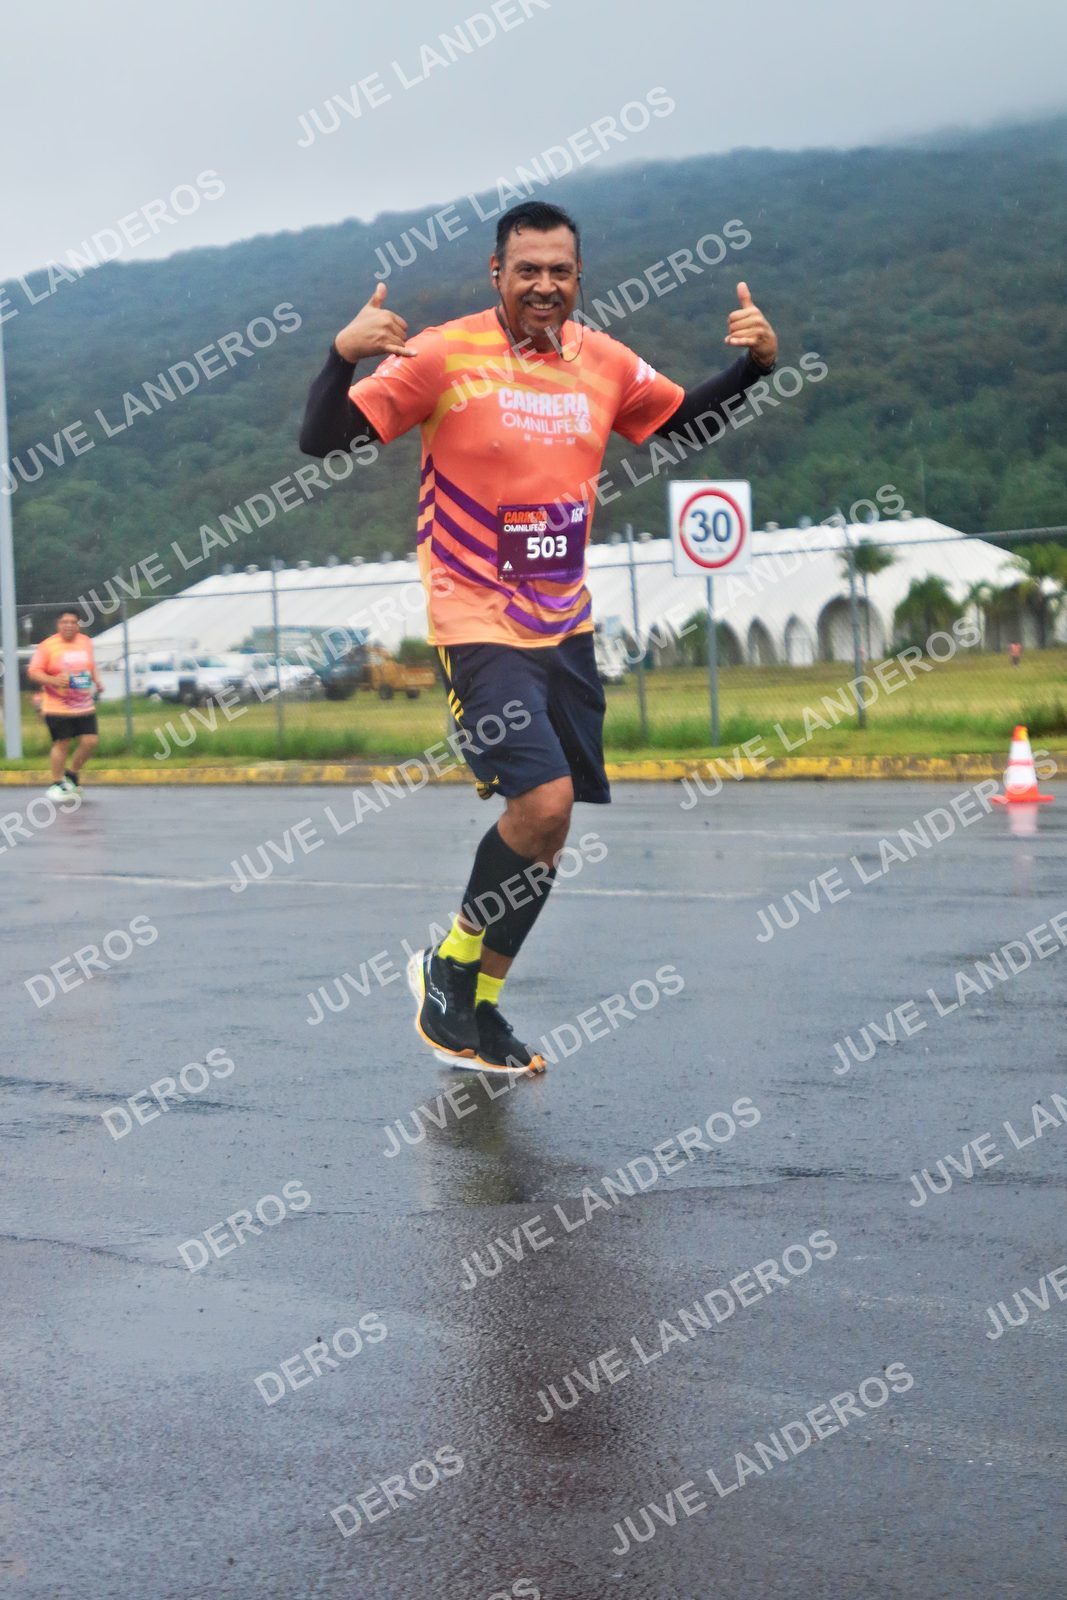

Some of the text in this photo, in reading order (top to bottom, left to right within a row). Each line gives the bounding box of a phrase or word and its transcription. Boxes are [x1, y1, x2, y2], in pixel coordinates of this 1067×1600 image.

[498, 387, 590, 416] CARRERA
[502, 412, 571, 434] OMNILIFE
[504, 510, 548, 524] CARRERA
[504, 523, 539, 532] OMNILIFE
[691, 509, 731, 542] 30
[526, 535, 567, 559] 503
